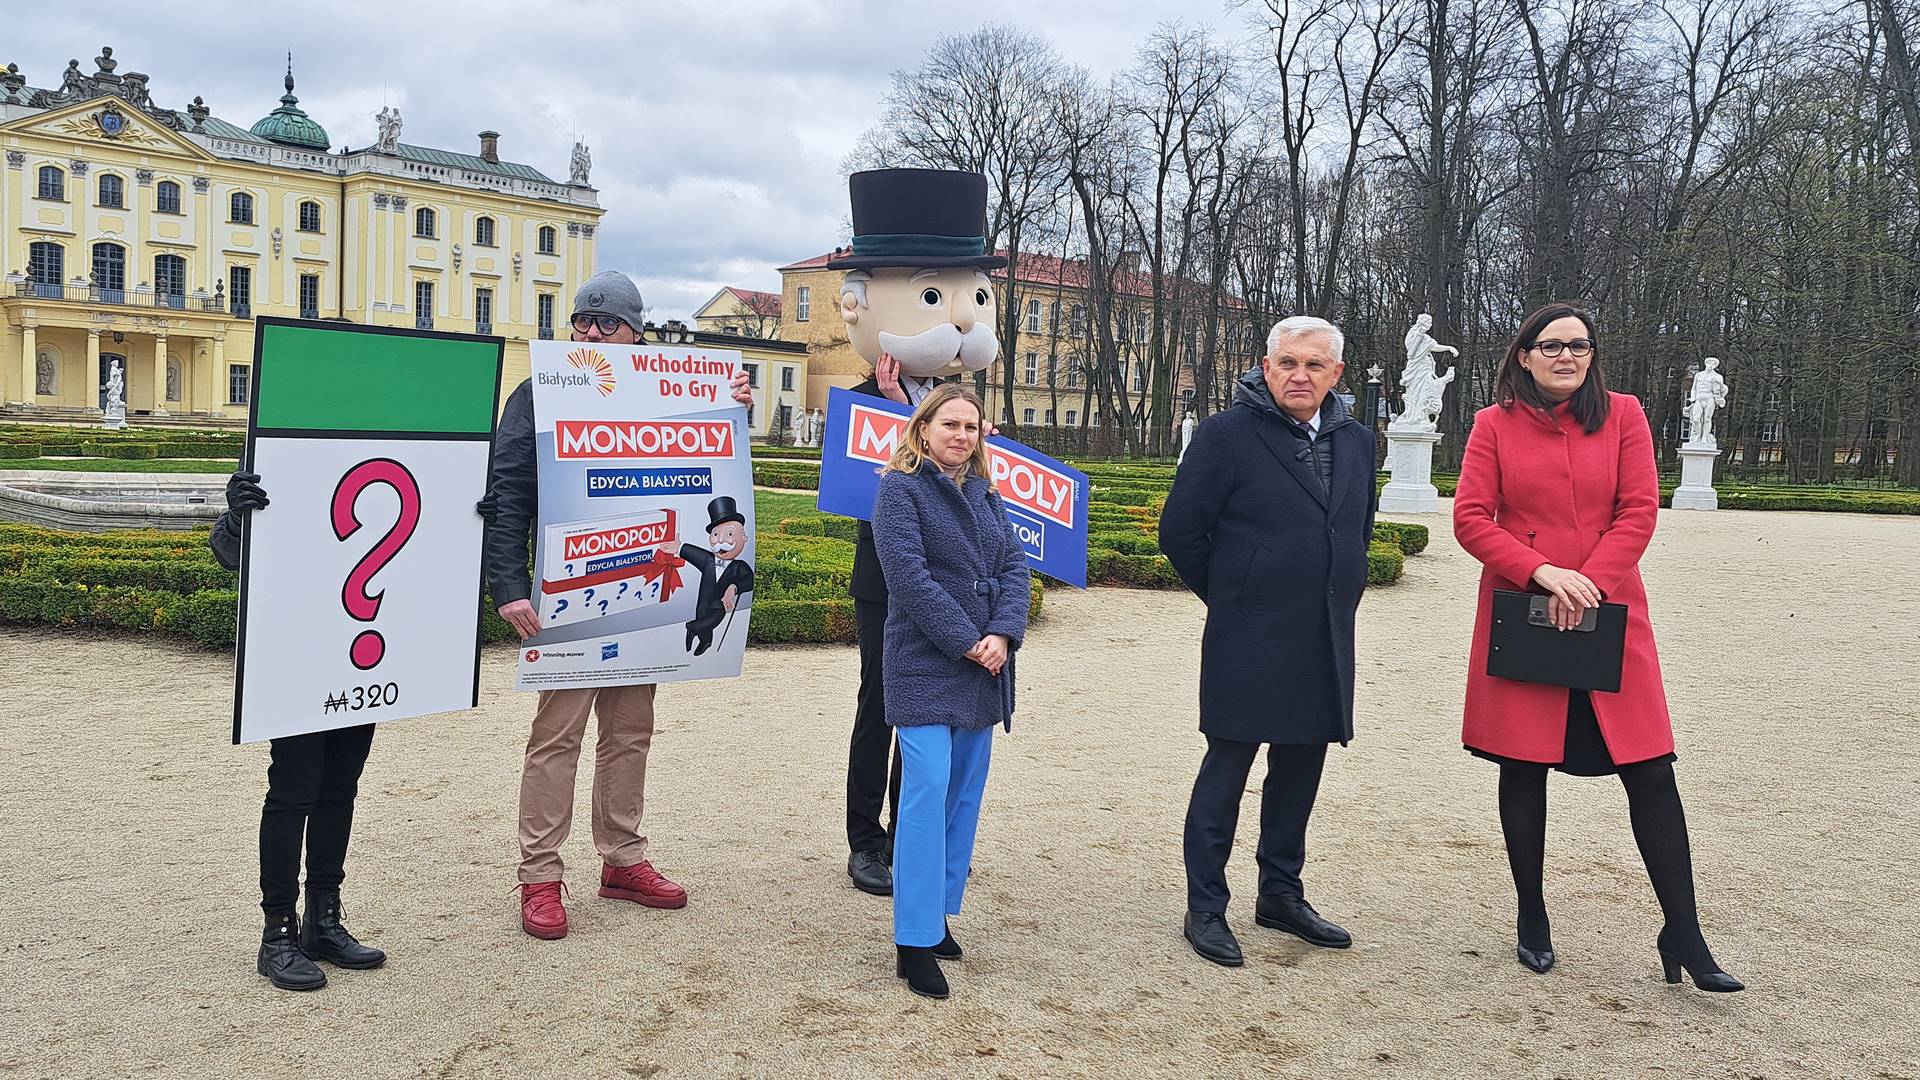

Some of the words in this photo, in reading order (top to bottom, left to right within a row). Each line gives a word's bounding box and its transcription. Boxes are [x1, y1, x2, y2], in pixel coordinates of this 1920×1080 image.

[631, 353, 735, 380] Wchodzimy
[538, 372, 591, 389] Białystok
[659, 379, 683, 397] Do
[689, 381, 718, 403] Gry
[562, 424, 728, 455] MONOPOLY
[590, 476, 640, 490] EDYCJA
[642, 473, 712, 489] BIAŁYSTOK
[567, 523, 668, 558] MONOPOLY
[587, 561, 615, 573] EDYCJA
[615, 553, 653, 567] BIAŁYSTOK
